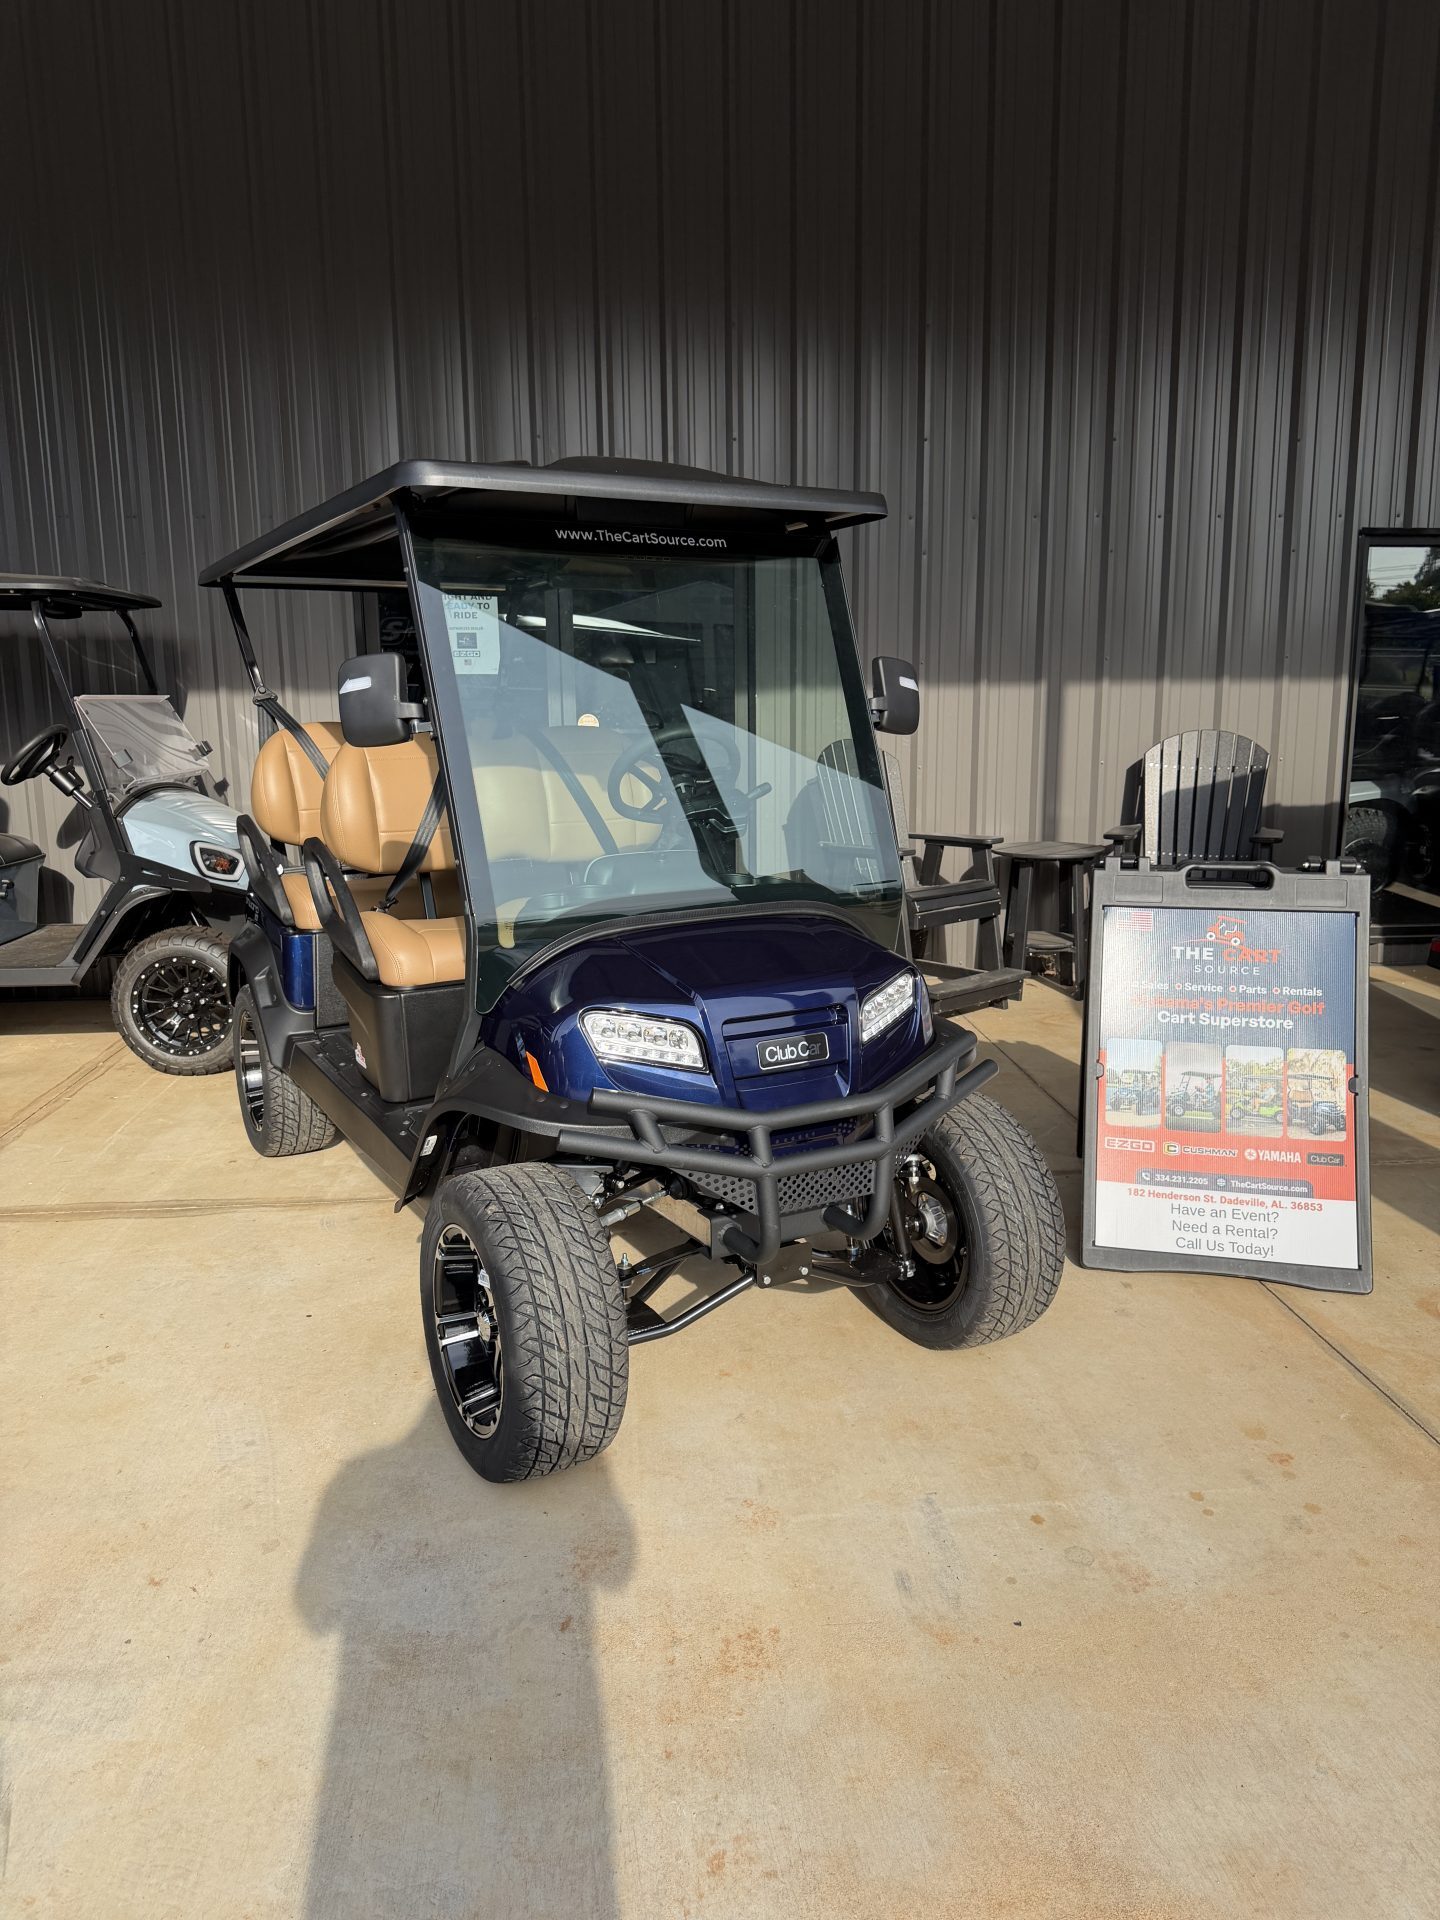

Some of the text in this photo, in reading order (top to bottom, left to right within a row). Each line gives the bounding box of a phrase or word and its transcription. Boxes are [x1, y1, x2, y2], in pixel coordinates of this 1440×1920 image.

[555, 529, 727, 548] www.TheCartSource.com
[1172, 946, 1281, 964] THE CART
[1194, 964, 1261, 976] SOURCE
[1184, 982, 1223, 993] Service
[1239, 984, 1267, 995] Parts
[1282, 986, 1322, 997] Rentals
[1217, 999, 1284, 1013] Premier
[1288, 1001, 1325, 1015] Golf
[1157, 1010, 1294, 1029] Cart Superstore
[765, 1041, 822, 1062] Club Car
[1182, 1146, 1236, 1157] CUSHMAN
[1258, 1150, 1301, 1163] YAMAHA
[1310, 1155, 1327, 1163] Club
[1327, 1156, 1340, 1164] Car
[1155, 1173, 1308, 1193] 334.231.2205 TheCartSource.com
[1128, 1188, 1323, 1211] 182 Henderson St. Dadeville, AL. 36853
[1171, 1203, 1279, 1223] Have an Event?
[1172, 1219, 1278, 1239] Need a Rental?
[1176, 1237, 1274, 1259] Call Us Today!
